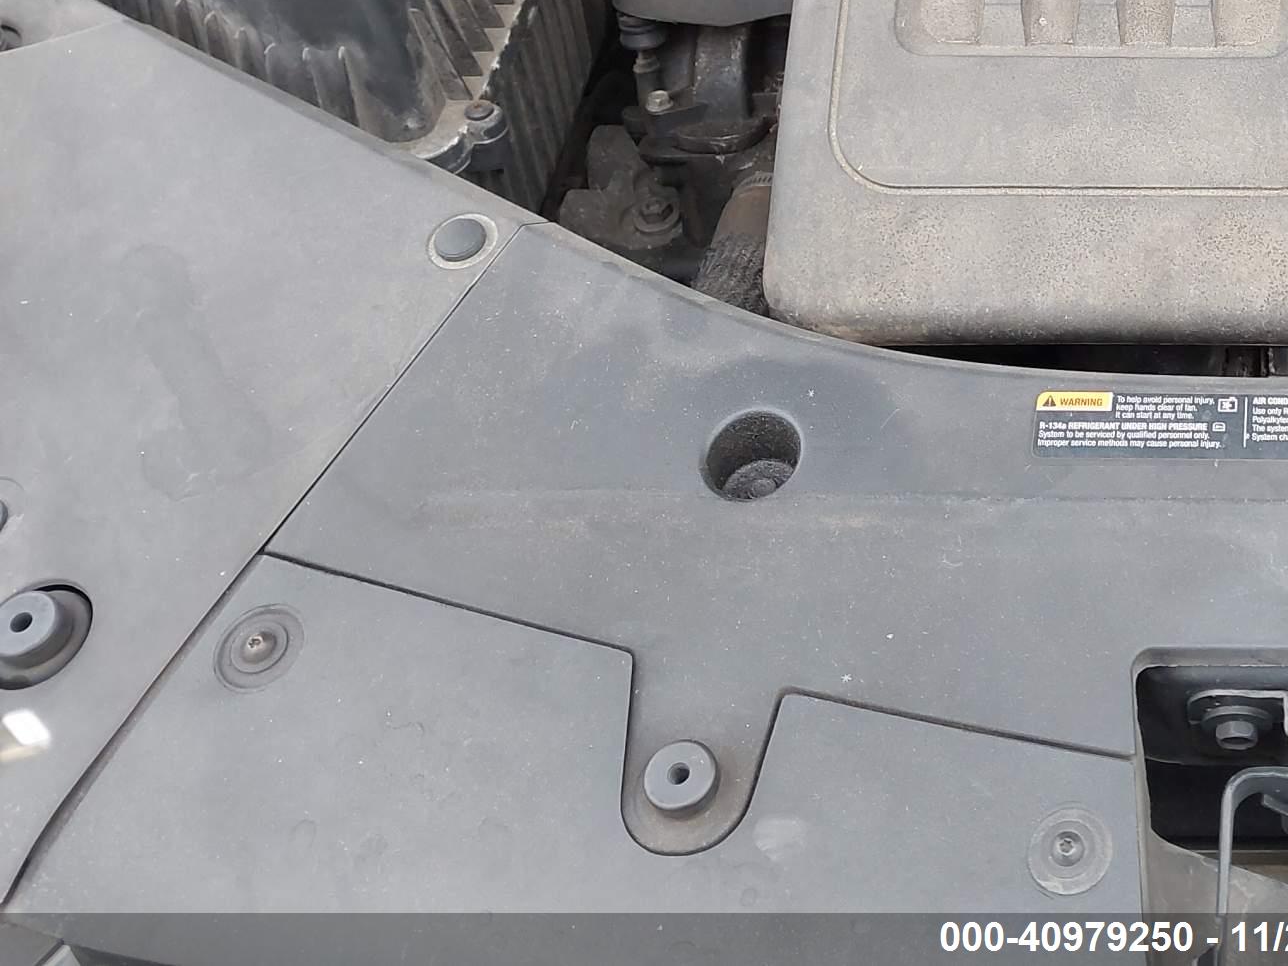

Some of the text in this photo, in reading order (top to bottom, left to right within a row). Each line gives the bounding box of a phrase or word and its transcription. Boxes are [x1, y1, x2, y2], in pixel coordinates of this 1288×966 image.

[1060, 398, 1102, 406] WARNING
[1116, 404, 1133, 412] keep
[1039, 431, 1064, 439] System
[1158, 432, 1189, 440] personnel
[1193, 432, 1210, 440] only.
[1038, 440, 1069, 448] Improper
[1169, 440, 1199, 448] personal
